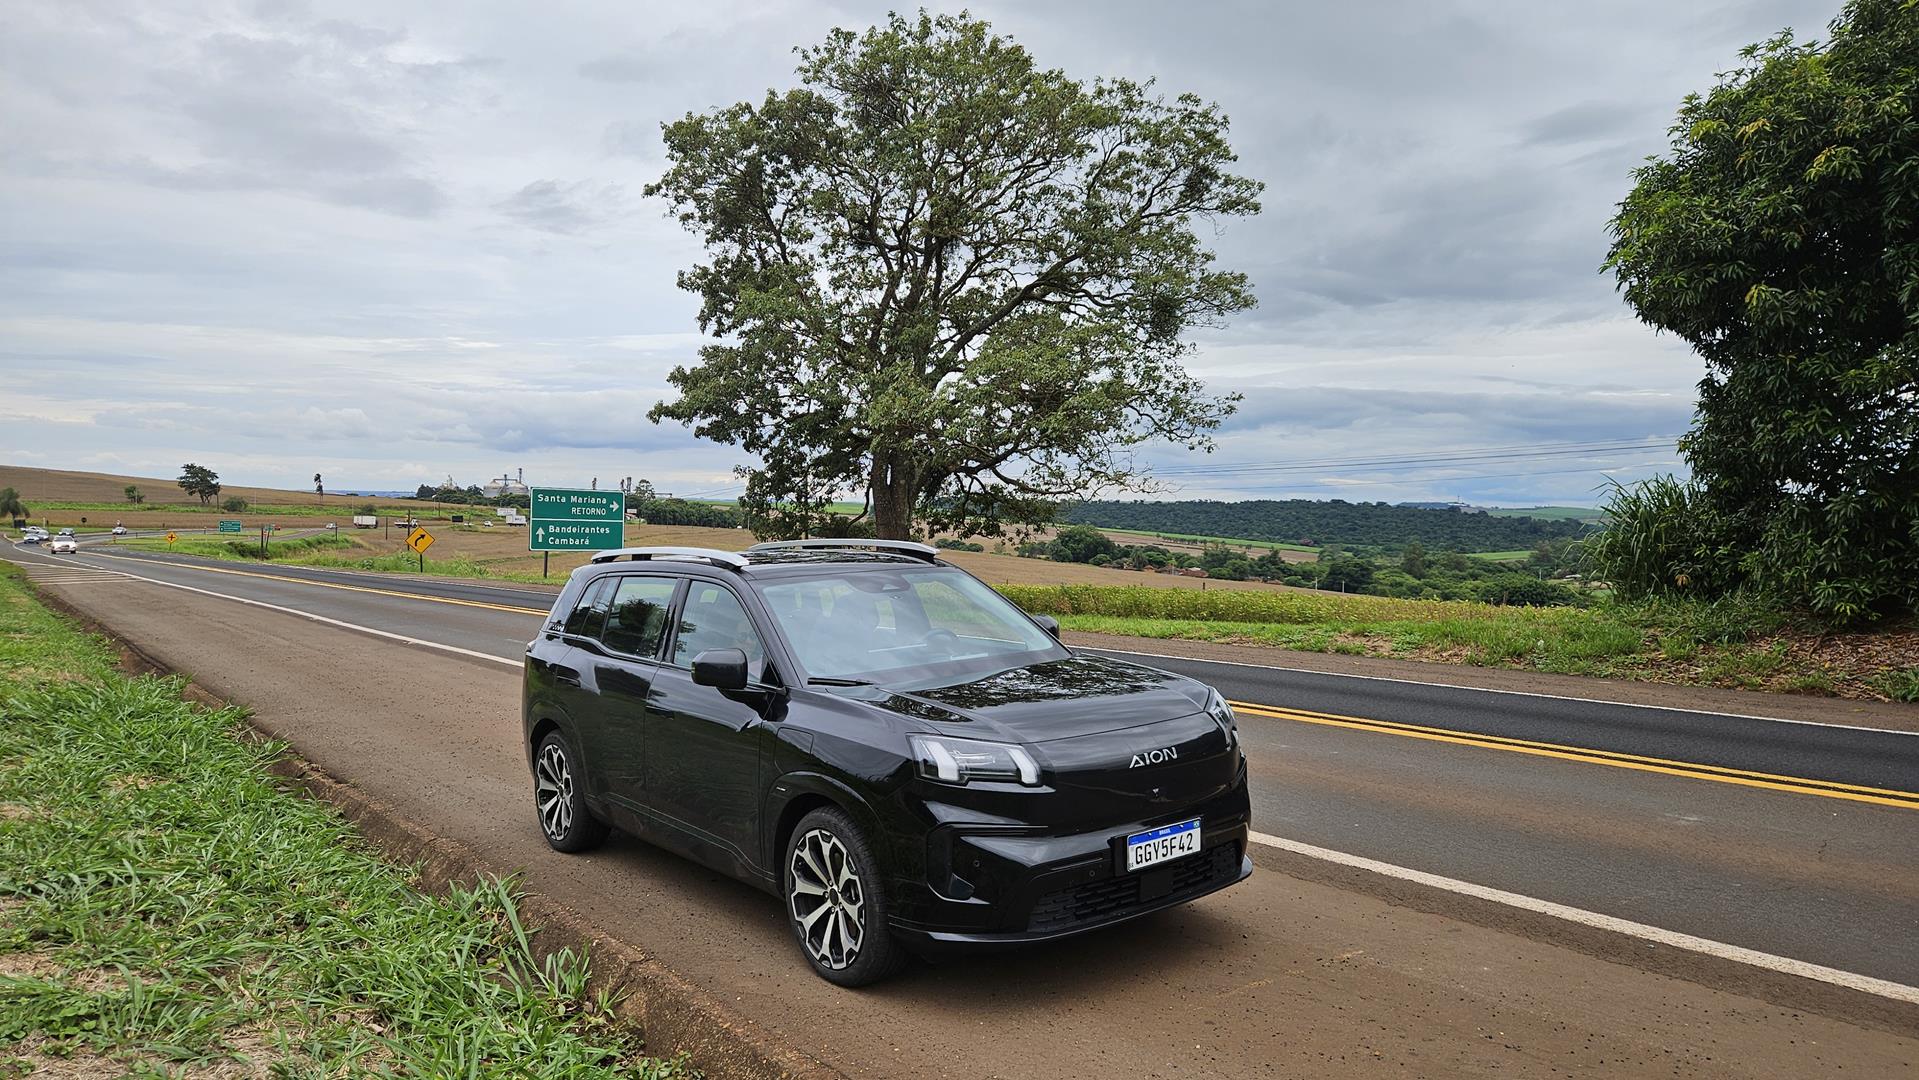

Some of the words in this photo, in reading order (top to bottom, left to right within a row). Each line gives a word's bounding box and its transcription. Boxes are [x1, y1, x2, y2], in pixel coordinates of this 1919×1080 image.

[537, 493, 566, 503] Santa
[570, 495, 607, 504] Mariana
[571, 507, 607, 516] RETORNO
[548, 525, 610, 534] Bandeirantes
[548, 536, 590, 545] Cambará
[1129, 747, 1178, 769] AION
[1135, 832, 1193, 865] GGY5F42
